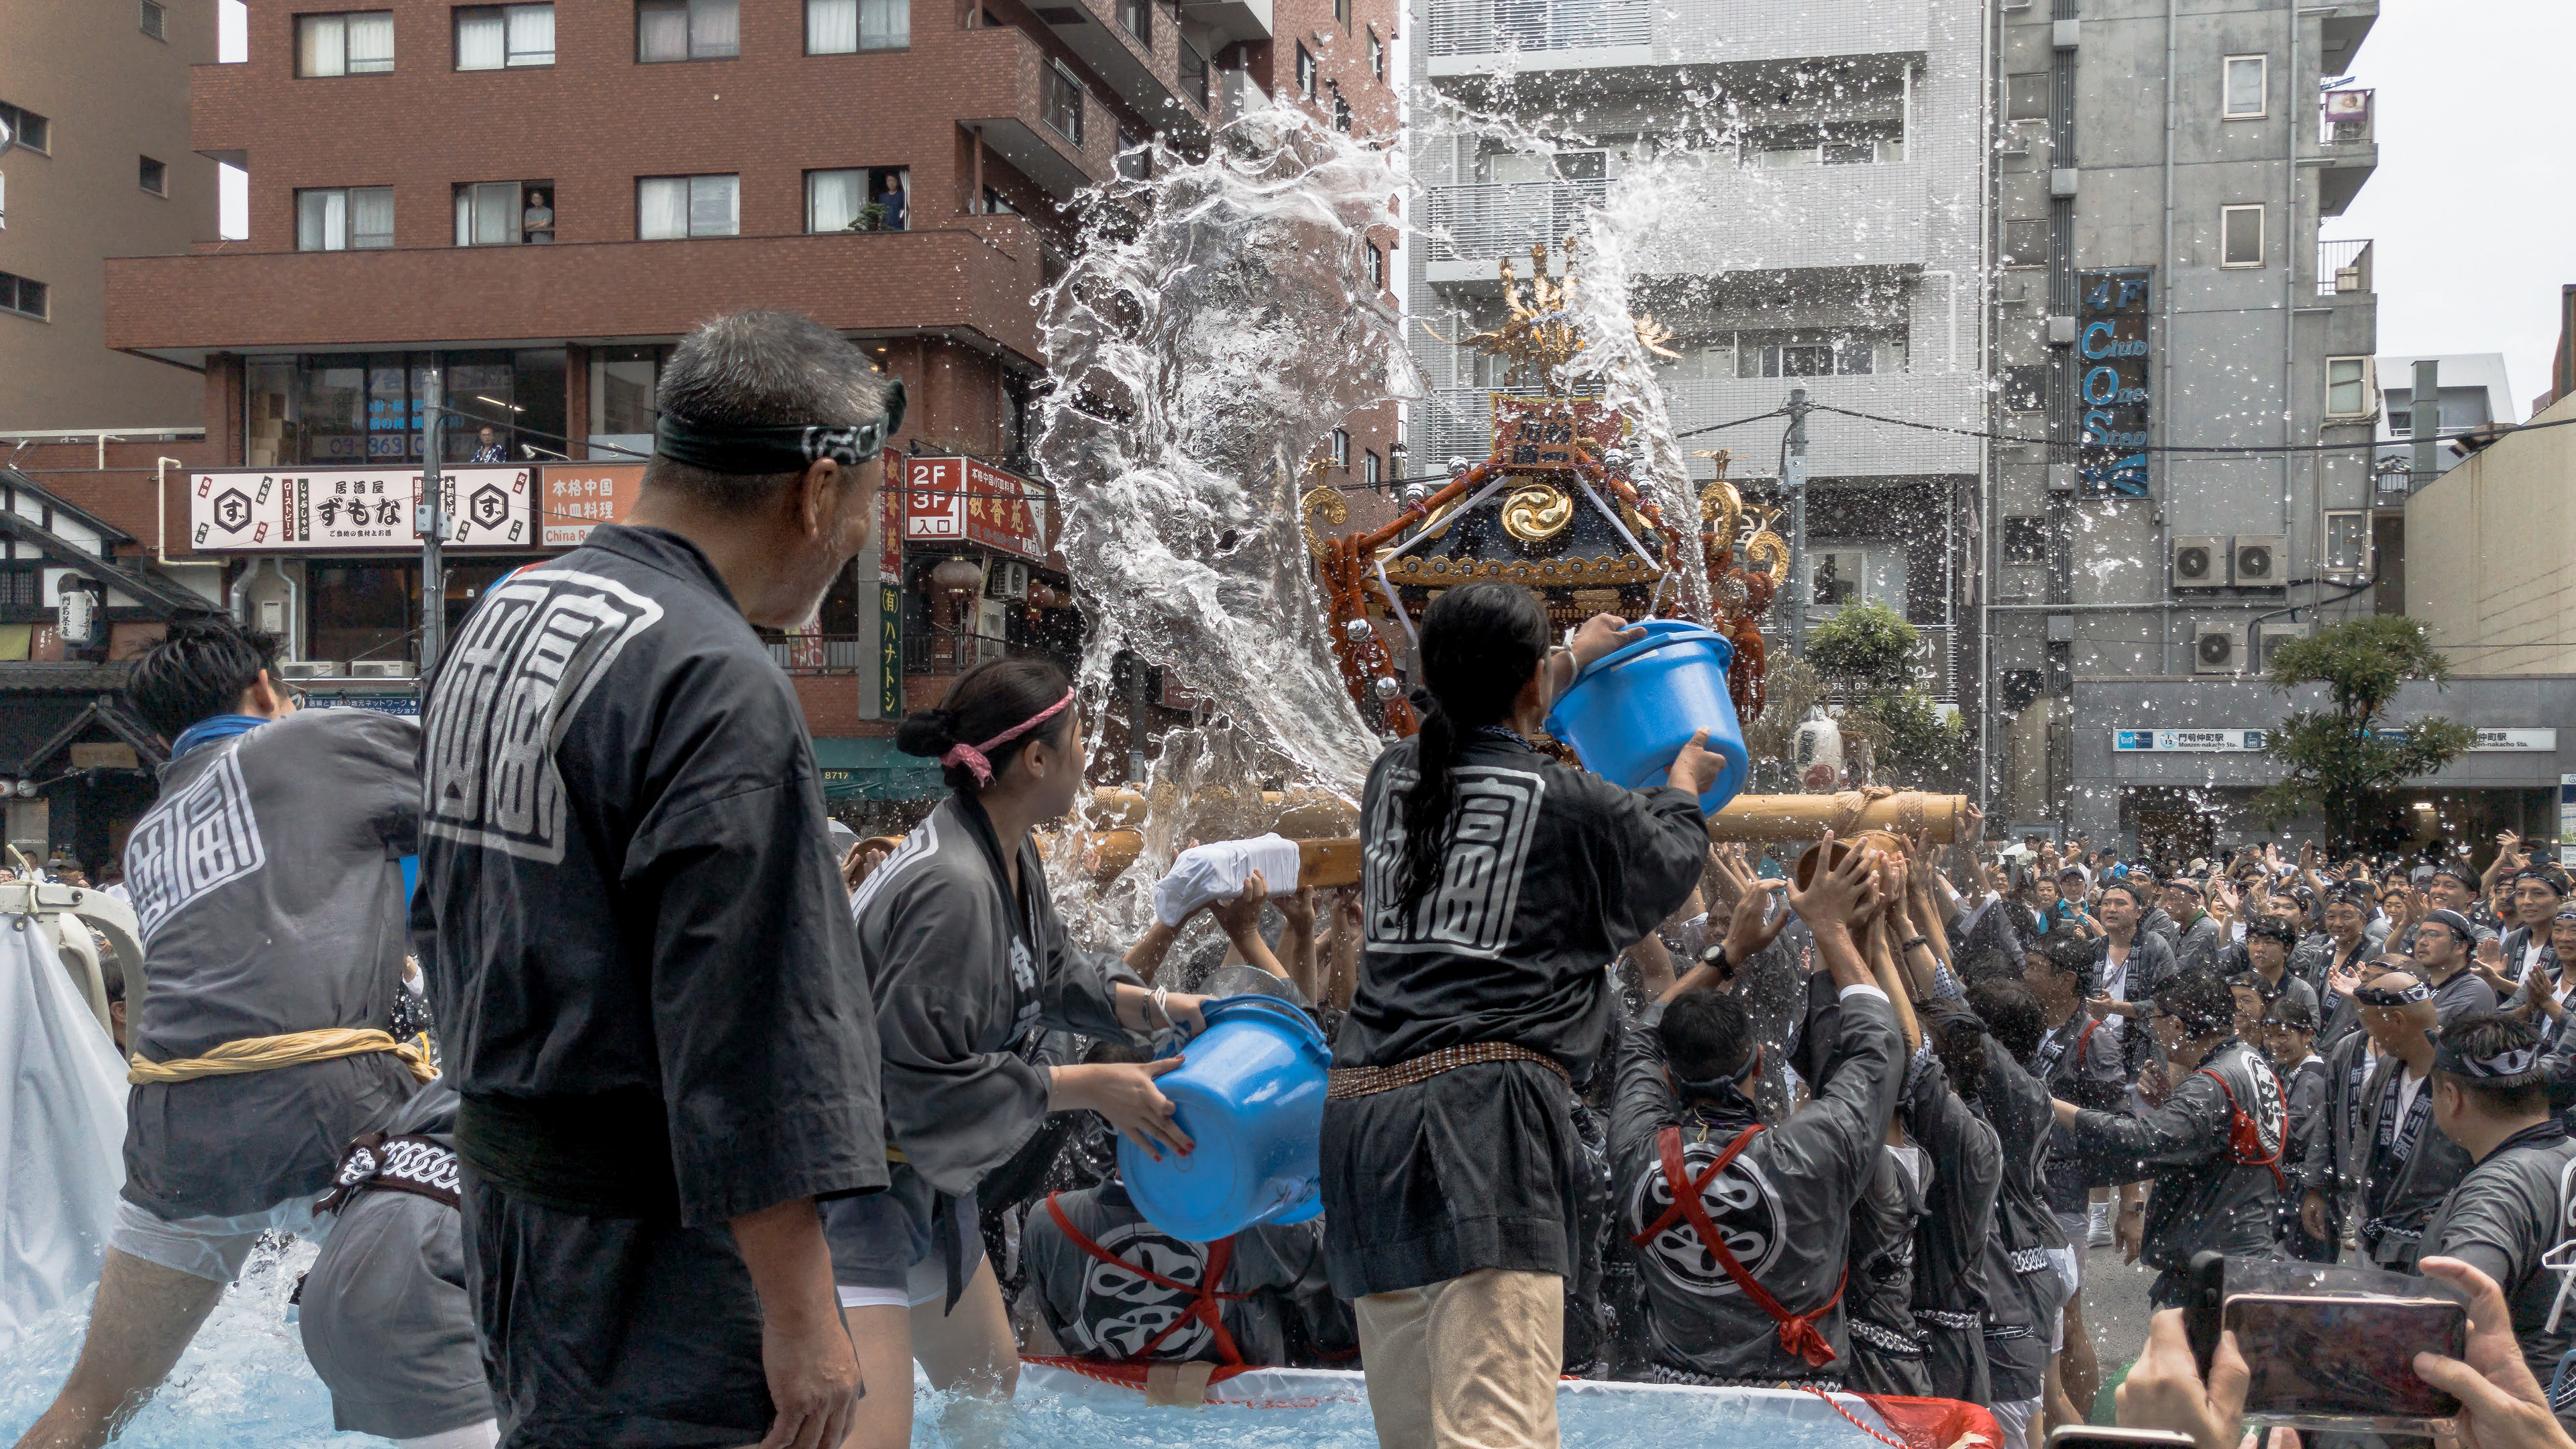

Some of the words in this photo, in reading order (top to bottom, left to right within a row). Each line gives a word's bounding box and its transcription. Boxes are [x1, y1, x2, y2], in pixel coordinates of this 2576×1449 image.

[2086, 280, 2143, 309] 4F
[2082, 319, 2147, 360] Club
[2083, 366, 2149, 406] One
[2084, 410, 2146, 446] Step
[335, 480, 384, 494] 居酒屋
[913, 466, 946, 485] 2F
[971, 468, 1015, 495] 本格中国小皿料理
[552, 478, 613, 497] 本格中国
[913, 489, 946, 509] 3F
[283, 482, 292, 537] ローストビーフ
[299, 482, 309, 535] しゃぶしゃぶ
[316, 496, 402, 527] ずもな
[553, 501, 614, 520] 小皿料理
[1034, 506, 1044, 520] 3F
[546, 529, 576, 542] China
[916, 519, 951, 535] 入口
[1024, 539, 1037, 553] 入口
[2178, 733, 2224, 742] 門前仲町駅
[824, 771, 849, 780] 8717
[2126, 946, 2141, 991] 新川一西
[2379, 1077, 2397, 1146] 新川一西
[2392, 1093, 2432, 1161] 新川一西
